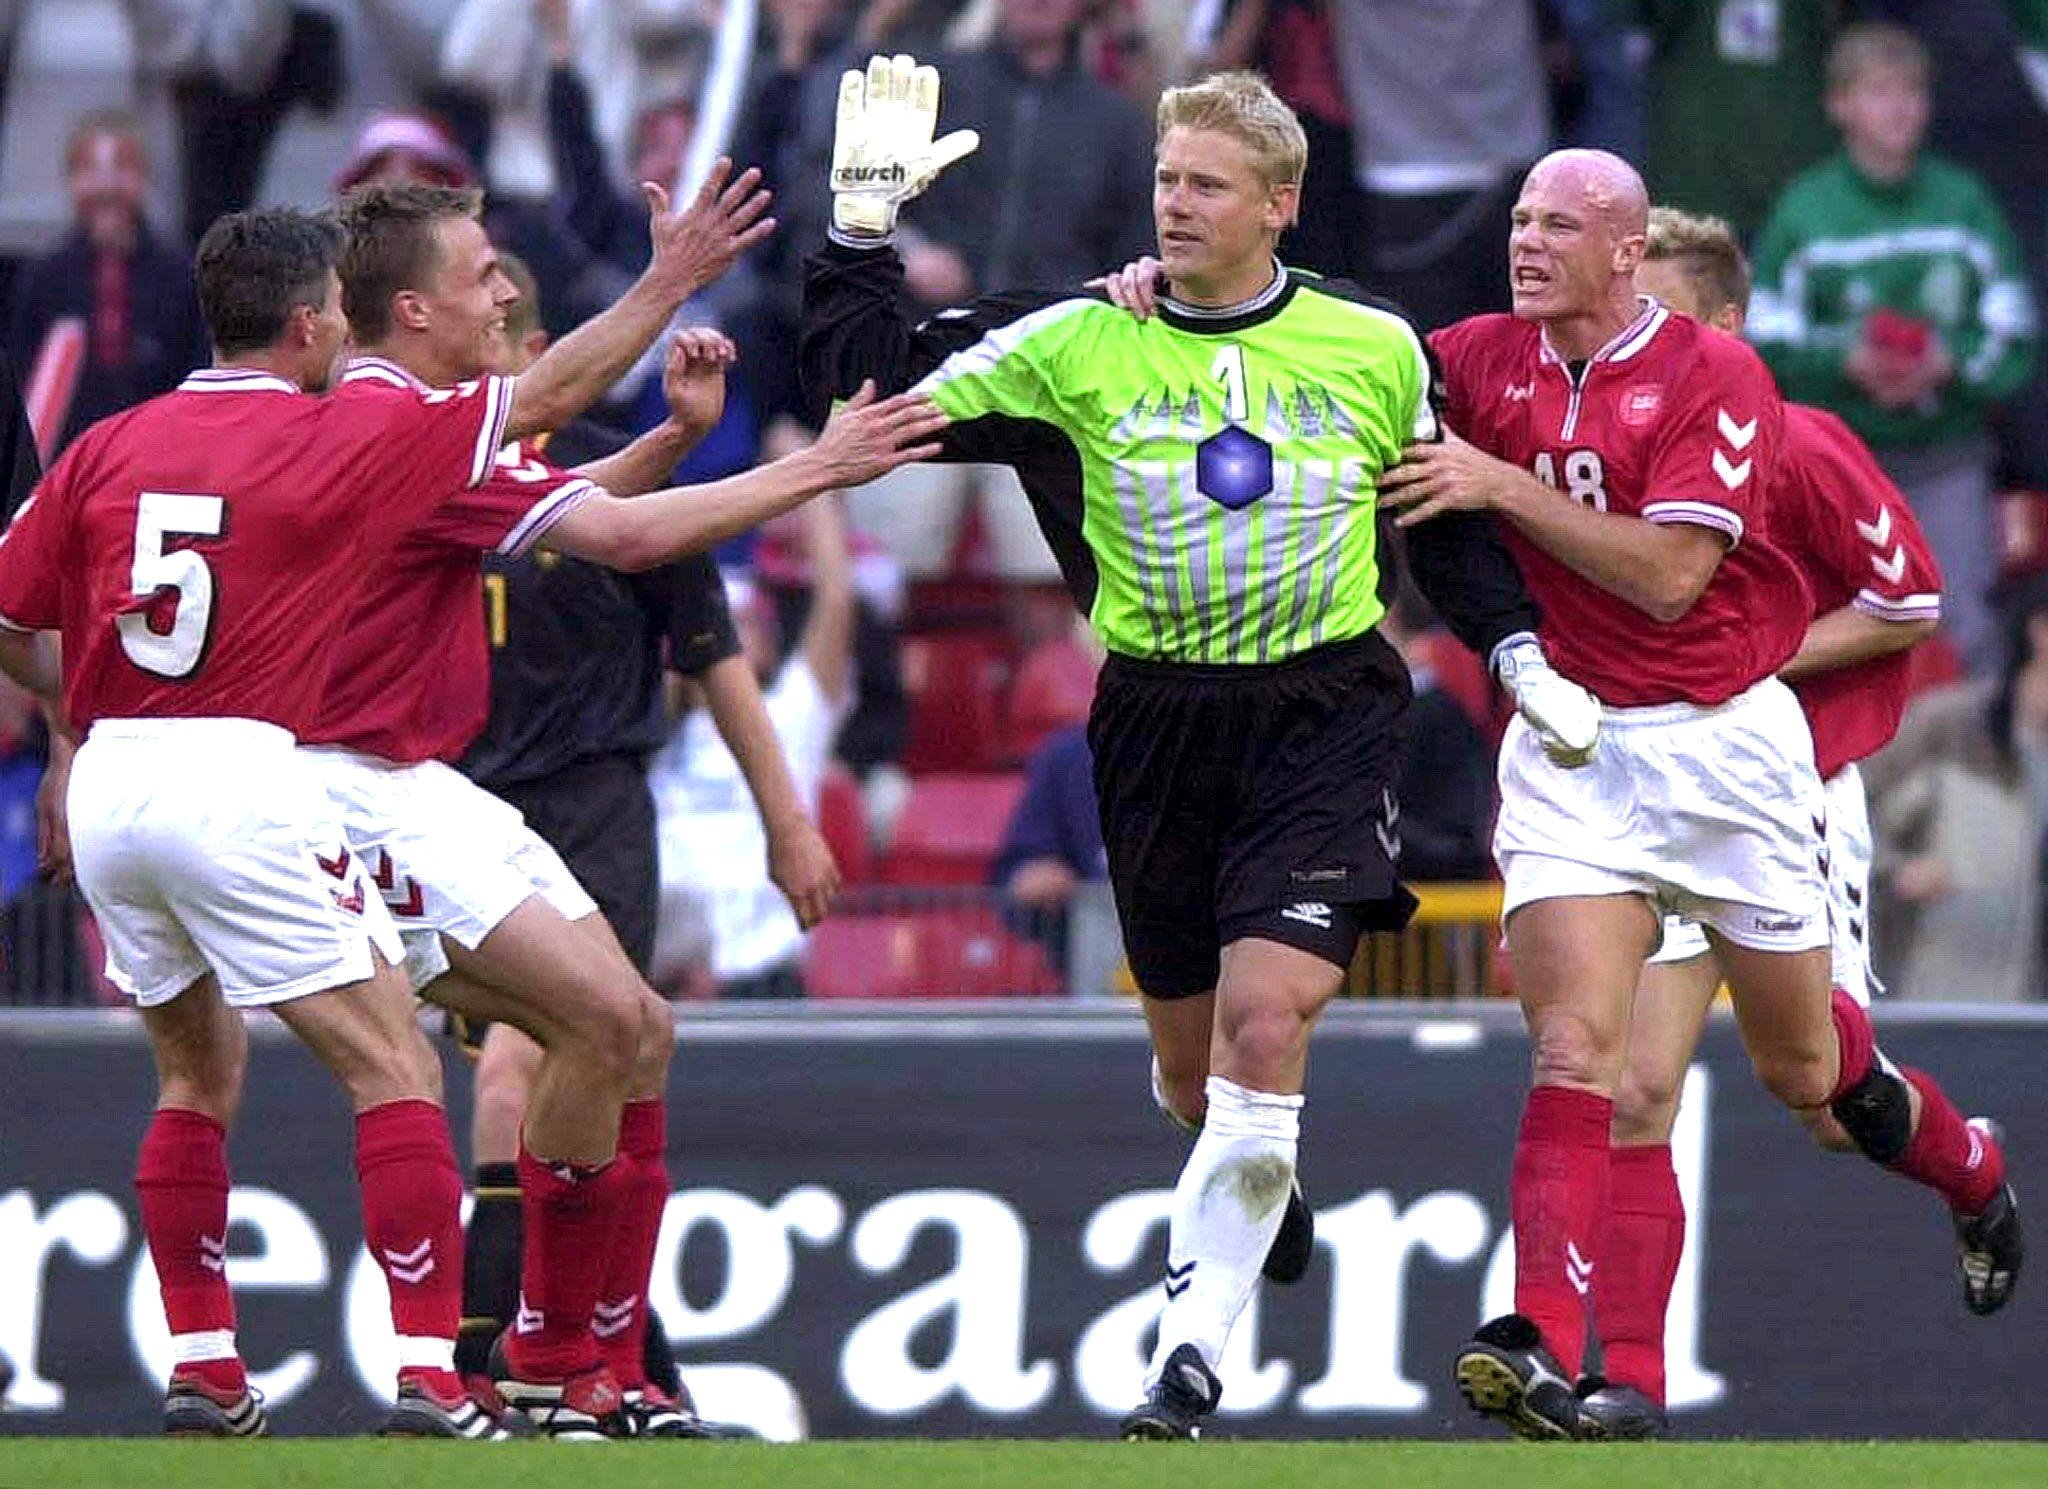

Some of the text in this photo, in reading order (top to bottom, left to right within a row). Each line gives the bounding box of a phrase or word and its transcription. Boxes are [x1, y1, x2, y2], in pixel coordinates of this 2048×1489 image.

[1211, 342, 1249, 421] 1
[115, 491, 225, 678] 5
[0, 1064, 1727, 1442] regaard
